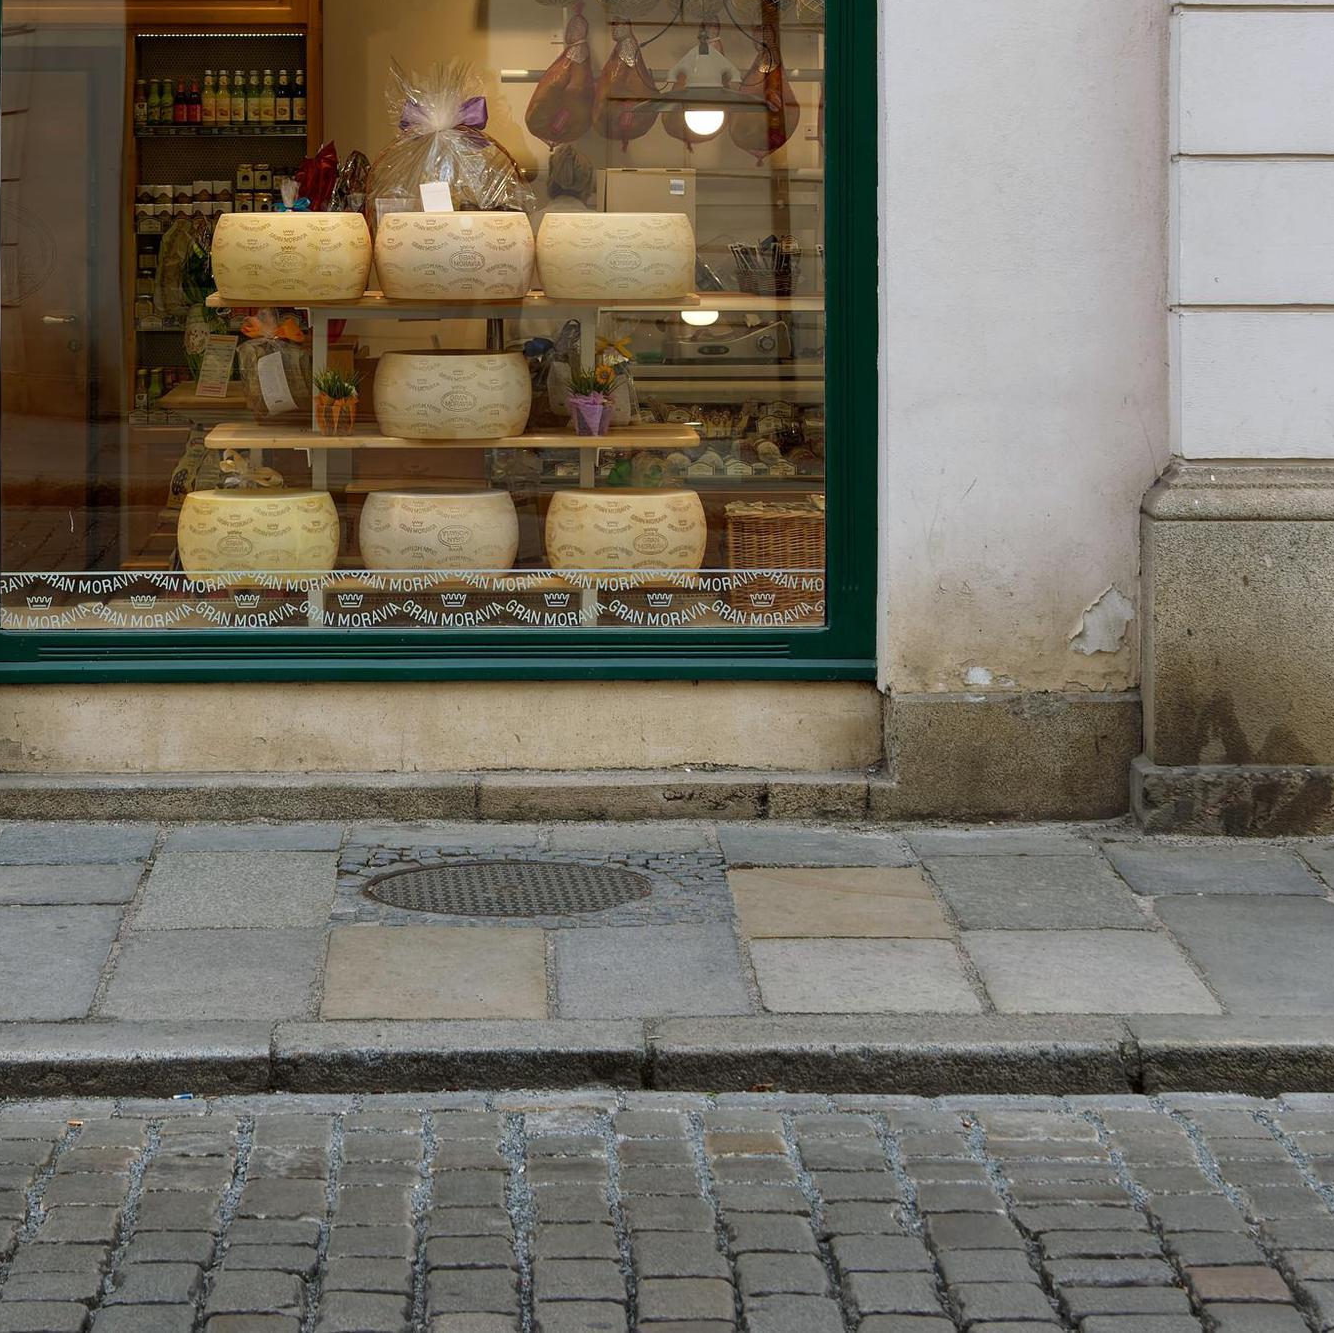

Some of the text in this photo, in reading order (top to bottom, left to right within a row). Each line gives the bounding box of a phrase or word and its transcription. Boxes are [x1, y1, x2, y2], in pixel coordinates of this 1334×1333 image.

[26, 602, 91, 628] MORAVIA
[91, 602, 127, 627] GRAN
[131, 602, 194, 628] MORAVIA
[195, 602, 231, 627] GRAN
[234, 601, 298, 627] MORAVIA
[299, 601, 334, 626] GRAN
[337, 601, 402, 627] MORAVIA
[402, 601, 437, 626] GRAN
[441, 601, 505, 627] MORAVIA
[505, 601, 541, 626] GRAN
[544, 601, 608, 627] MORAVIA
[609, 600, 643, 625] GRAN
[646, 600, 711, 626] MORAVIA
[712, 600, 746, 625] GRAN
[750, 600, 815, 626] MORAVIA
